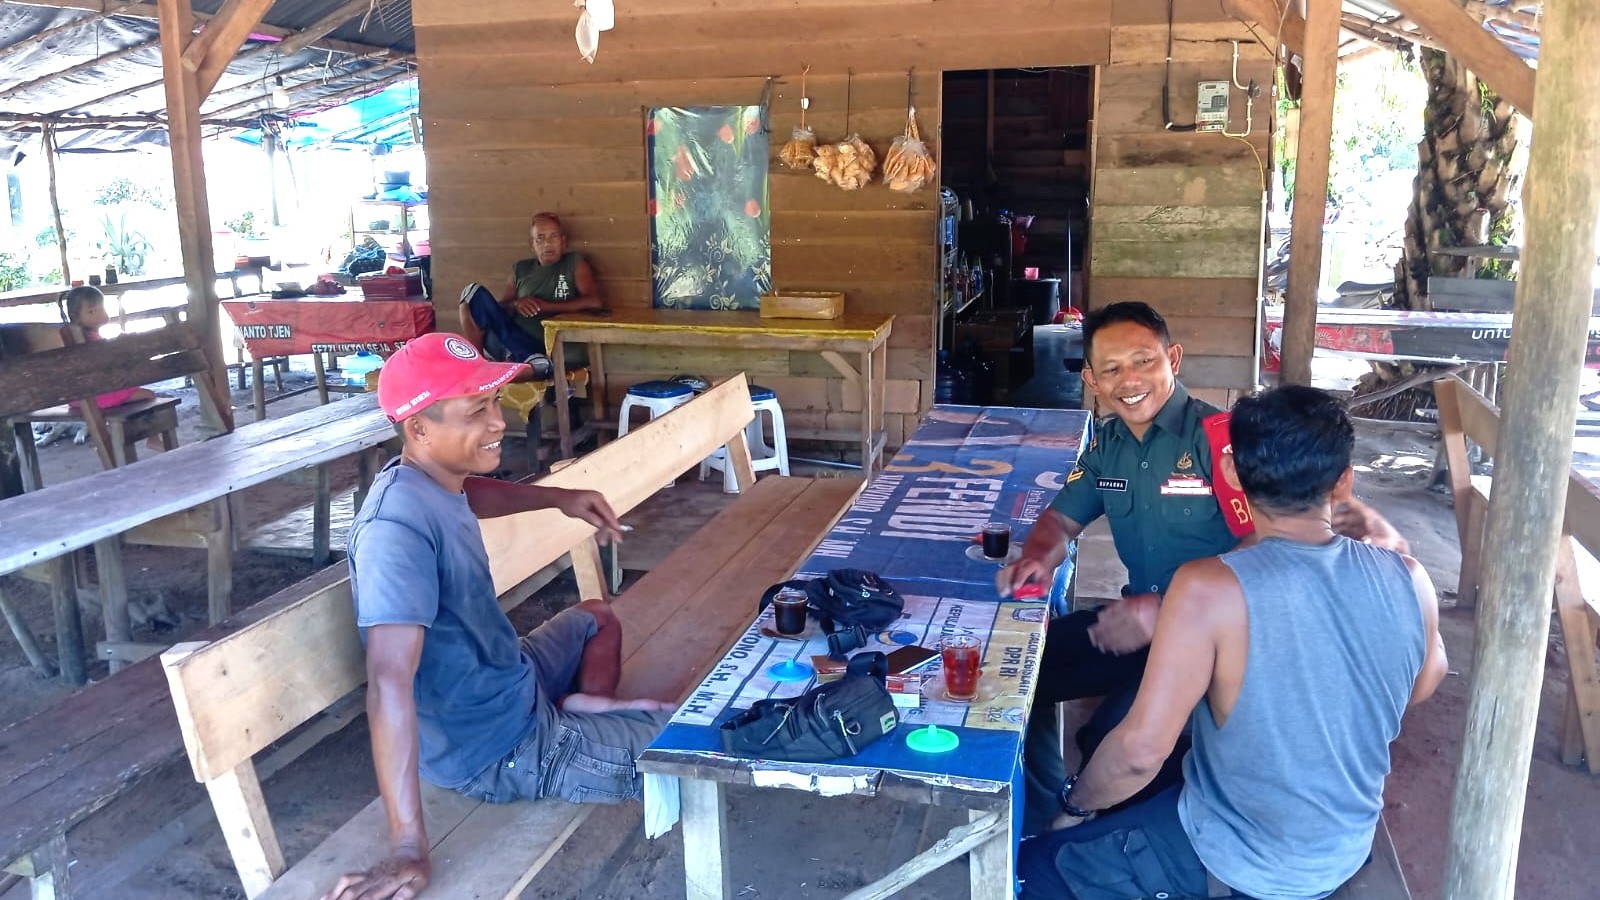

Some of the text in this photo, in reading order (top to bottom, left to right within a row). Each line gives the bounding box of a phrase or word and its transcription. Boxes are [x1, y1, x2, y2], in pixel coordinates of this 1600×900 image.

[268, 325, 291, 338] TJEN
[1471, 328, 1512, 340] untu
[880, 476, 1004, 541] FENDI
[998, 647, 1022, 677] DPR RI
